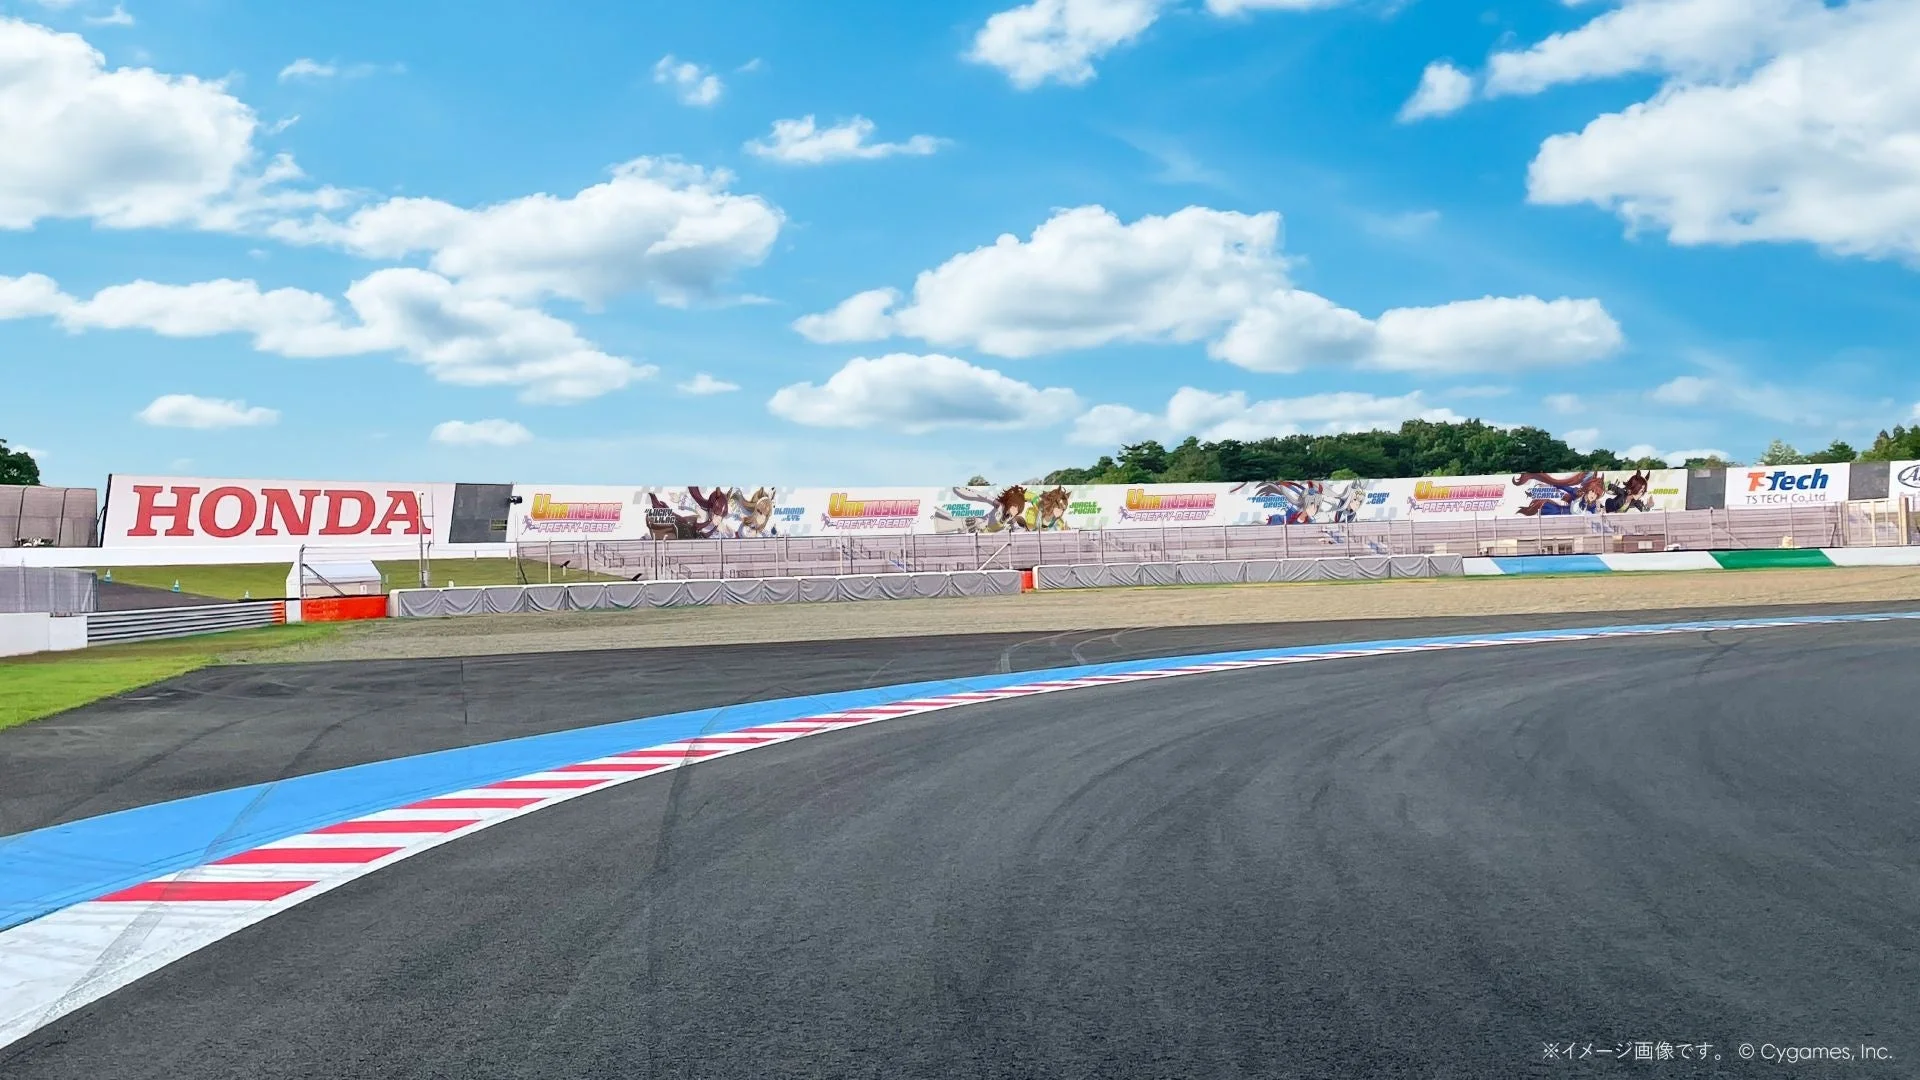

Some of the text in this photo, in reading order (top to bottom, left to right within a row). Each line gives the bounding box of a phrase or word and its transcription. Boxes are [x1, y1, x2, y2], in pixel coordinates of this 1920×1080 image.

[1746, 495, 1757, 504] TS
[1761, 494, 1787, 503] TECH
[127, 485, 431, 537] HONDA
[648, 508, 673, 517] LUCKY
[774, 507, 805, 515] ALMOND
[654, 516, 676, 524] LILAC
